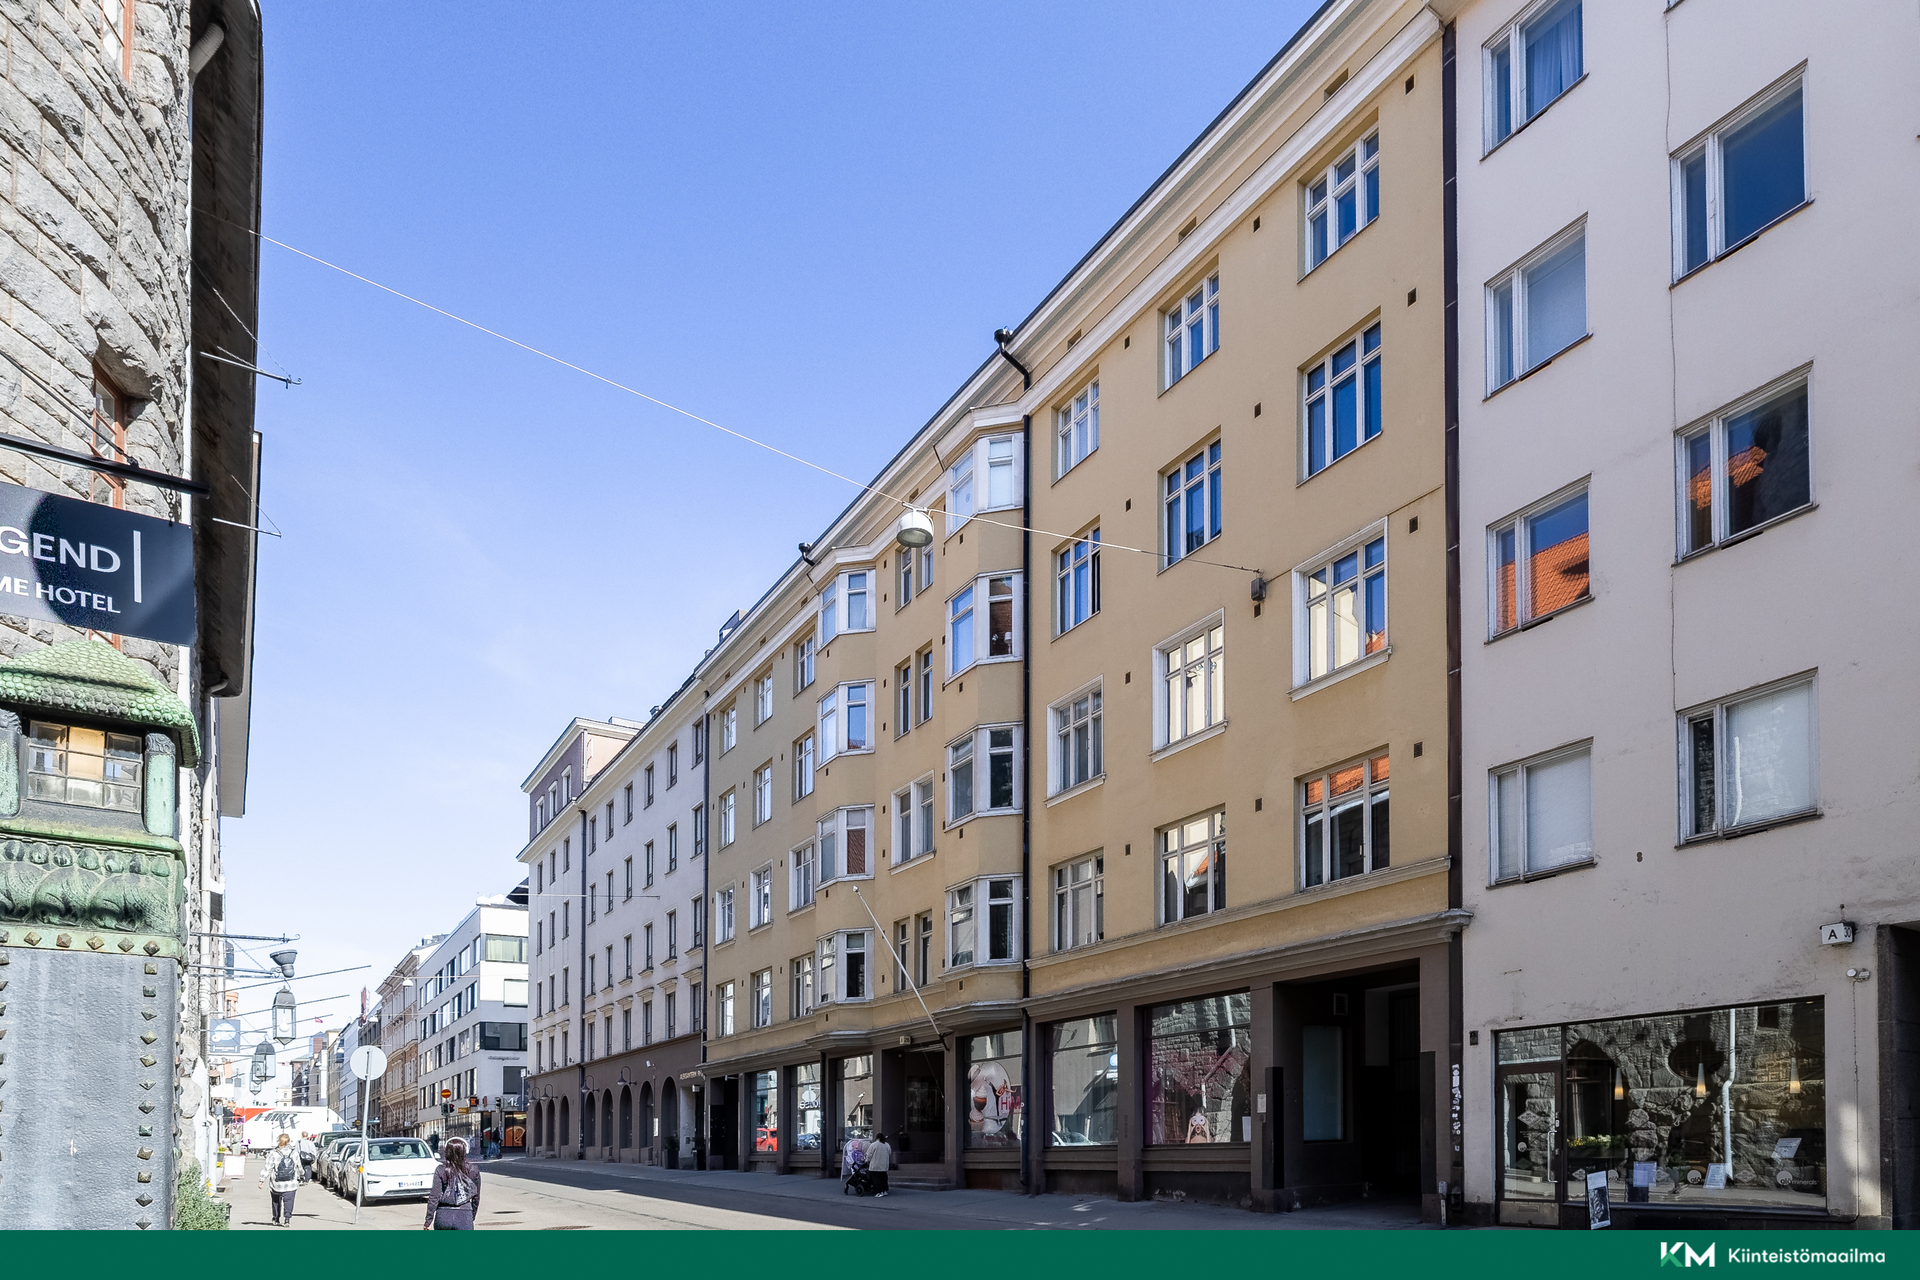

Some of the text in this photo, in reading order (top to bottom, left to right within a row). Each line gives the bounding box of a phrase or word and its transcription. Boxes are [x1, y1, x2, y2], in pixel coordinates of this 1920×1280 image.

[0, 526, 121, 573] GEND
[35, 582, 121, 614] HOTEL
[1828, 929, 1838, 940] A
